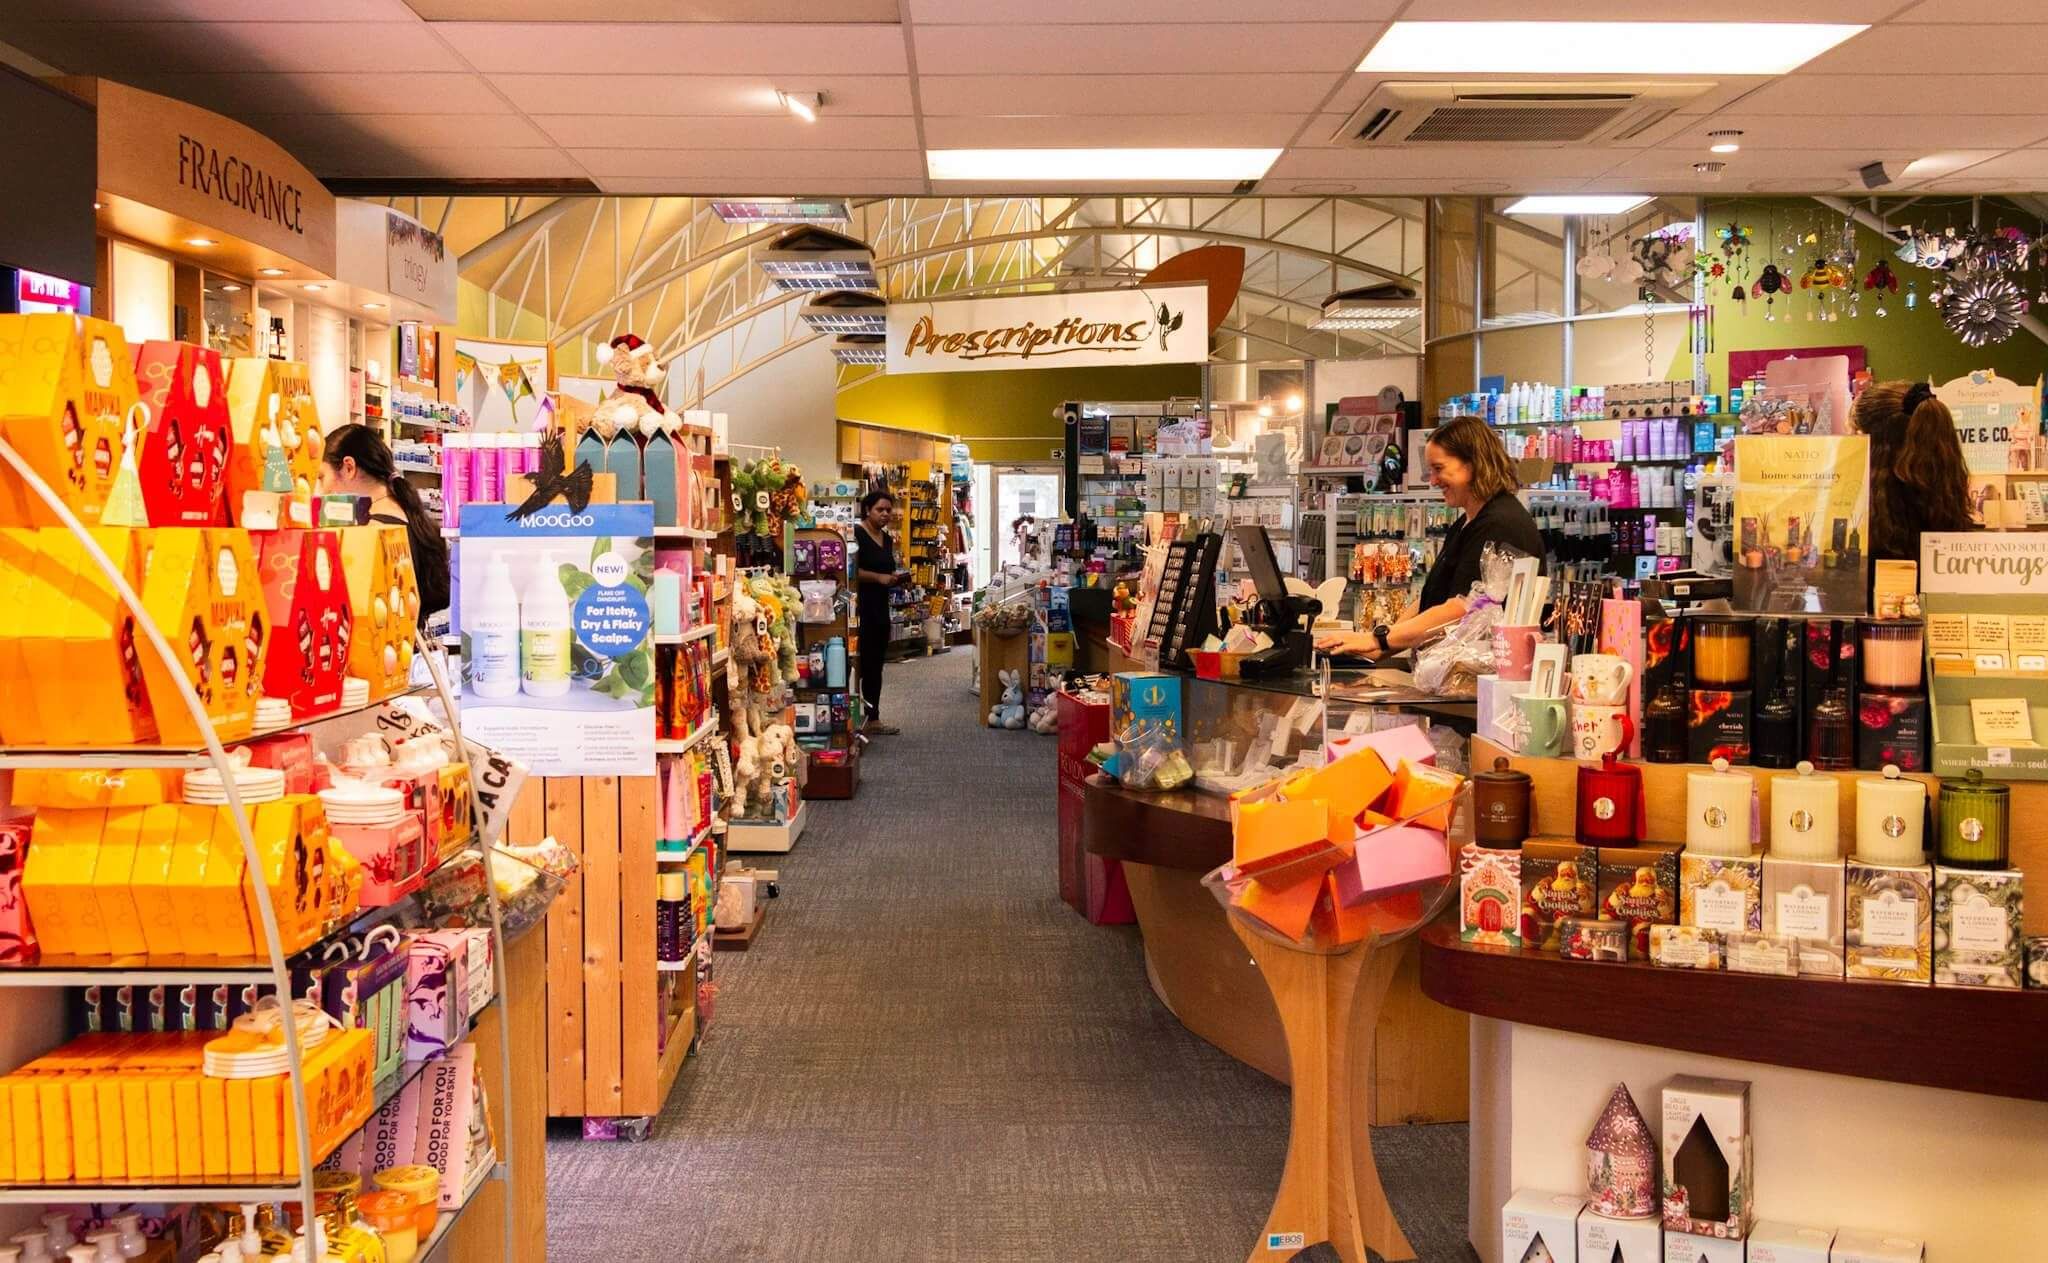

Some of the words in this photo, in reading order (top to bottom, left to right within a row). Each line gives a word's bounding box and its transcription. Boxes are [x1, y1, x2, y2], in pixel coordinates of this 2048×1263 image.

[178, 134, 304, 235] FRAGRANCE
[404, 256, 429, 292] trilogy
[904, 314, 1147, 360] Prescriptions
[1956, 427, 1976, 443] VE
[1979, 427, 1989, 443] &
[1993, 426, 2012, 443] CO.
[1760, 469, 1790, 481] home
[1791, 469, 1842, 483] sanctuary
[1950, 543, 1986, 553] HEART
[1993, 543, 2017, 553] AND
[597, 565, 624, 575] NEW!
[1933, 549, 2048, 586] Earrings
[586, 605, 605, 616] For
[606, 605, 637, 618] Itchy,
[581, 620, 601, 632] Dry
[602, 620, 611, 630] &
[612, 620, 643, 632] Flaky
[591, 632, 633, 645] Scalps.
[1151, 685, 1159, 705] 1
[1718, 722, 1744, 731] cherish
[433, 1066, 449, 1097] YOU
[445, 1066, 457, 1091] SKIN
[431, 1097, 445, 1126] FOR
[443, 1091, 454, 1118] YOUR
[389, 1120, 399, 1140] FOR
[441, 1119, 452, 1140] FOR
[386, 1142, 397, 1169] OOD
[438, 1142, 450, 1175] GOOD
